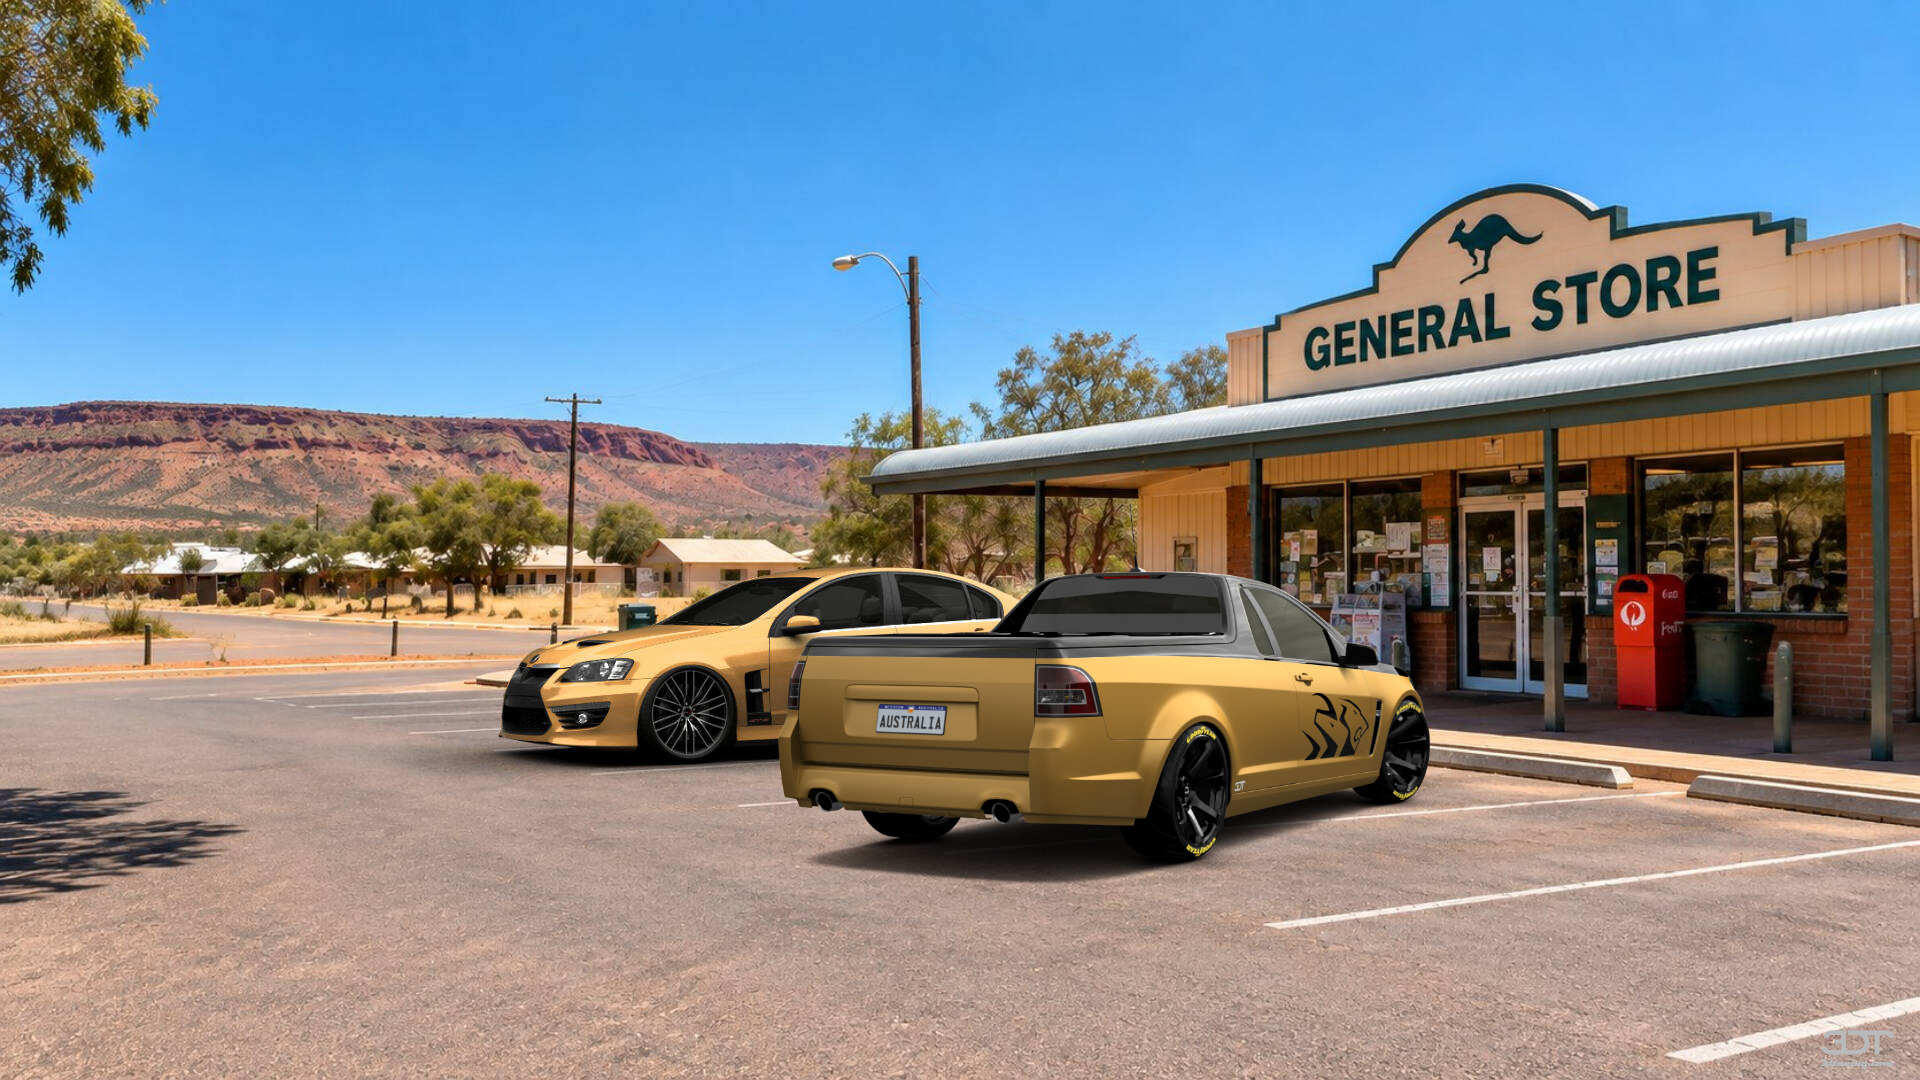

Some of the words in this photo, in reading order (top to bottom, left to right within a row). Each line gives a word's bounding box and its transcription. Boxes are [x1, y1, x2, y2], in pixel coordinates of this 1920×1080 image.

[1303, 292, 1511, 372] GENERAL
[1530, 245, 1720, 332] STORE
[879, 714, 942, 730] AUSTRALIA
[1186, 726, 1216, 744] GOODYEAR
